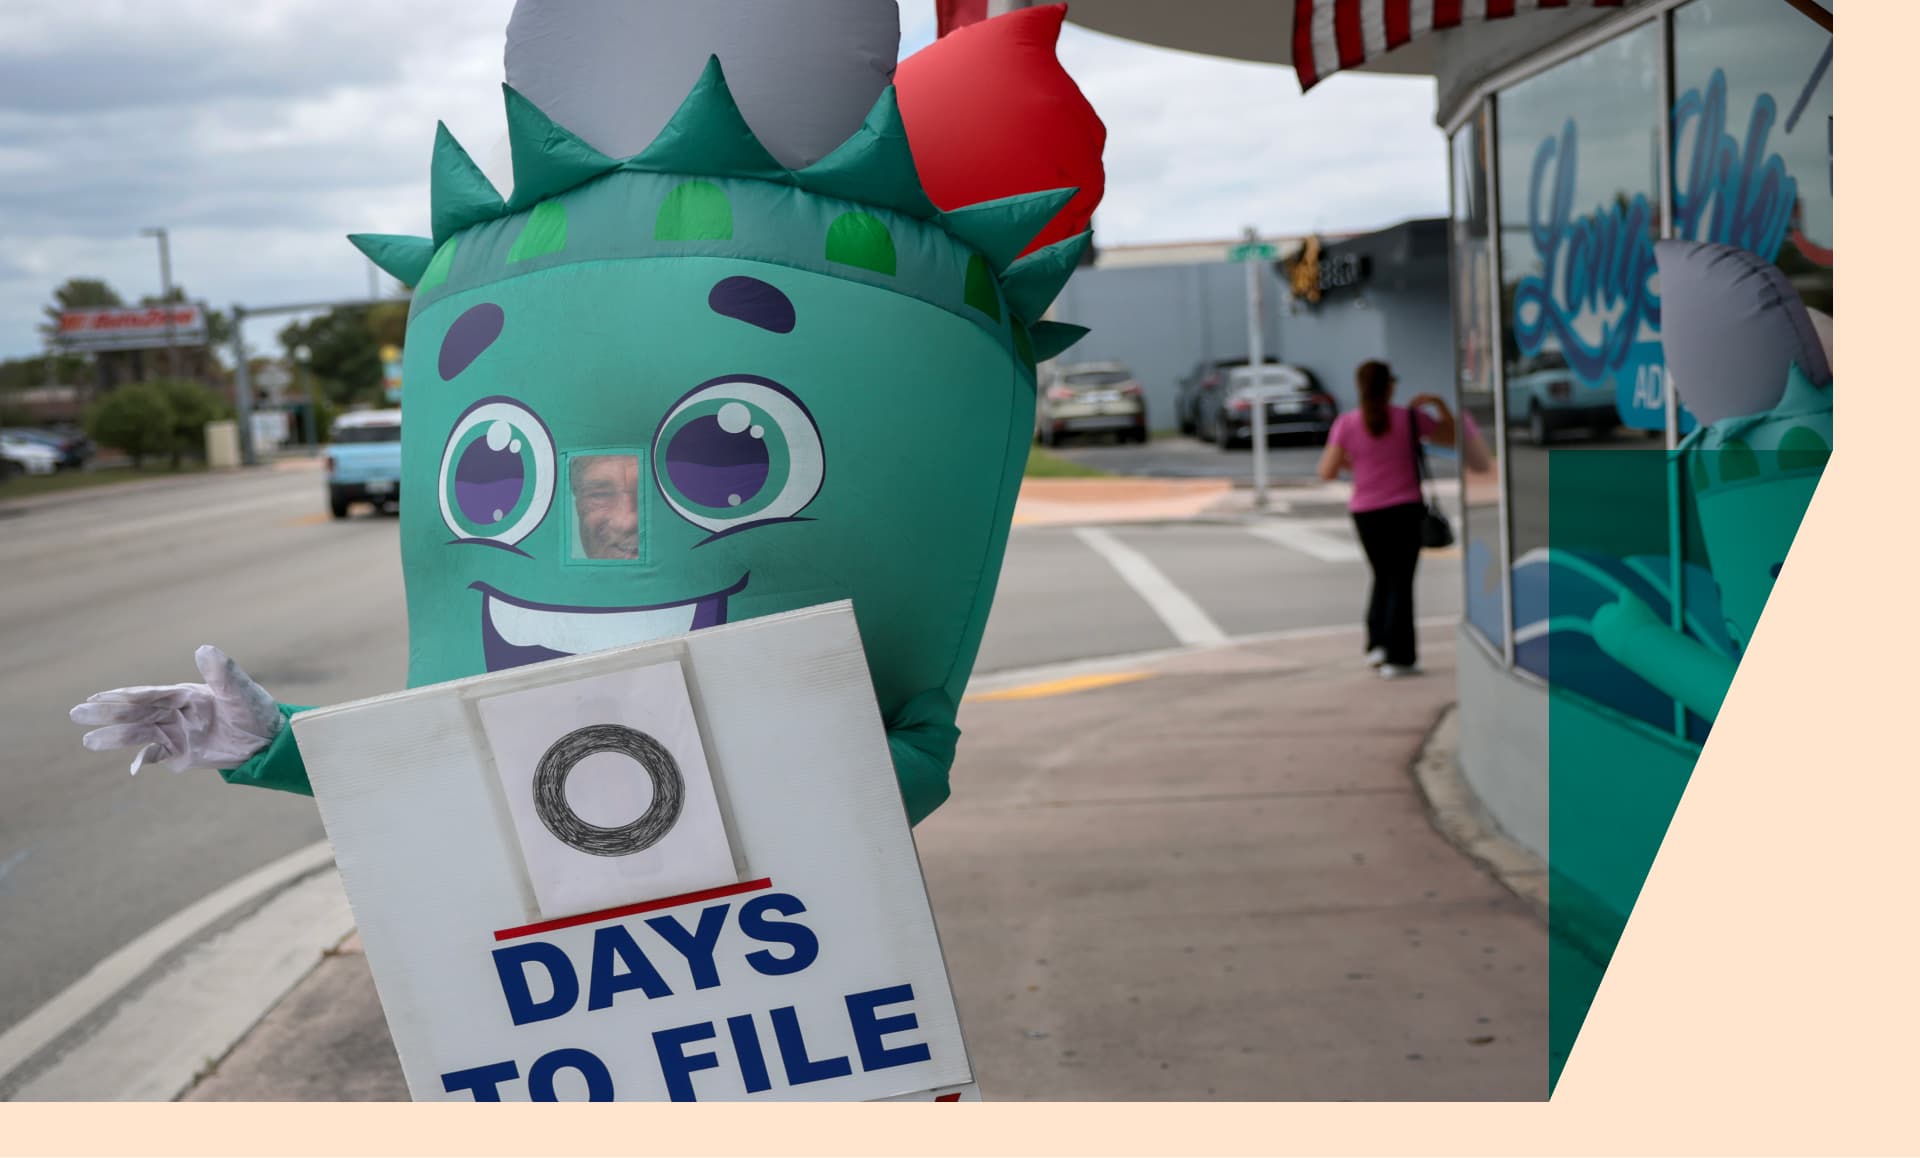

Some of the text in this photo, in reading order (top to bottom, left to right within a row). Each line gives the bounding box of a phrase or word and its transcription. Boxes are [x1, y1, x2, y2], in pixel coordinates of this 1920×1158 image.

[492, 893, 820, 1026] DAYS
[441, 984, 932, 1102] TO FILE
